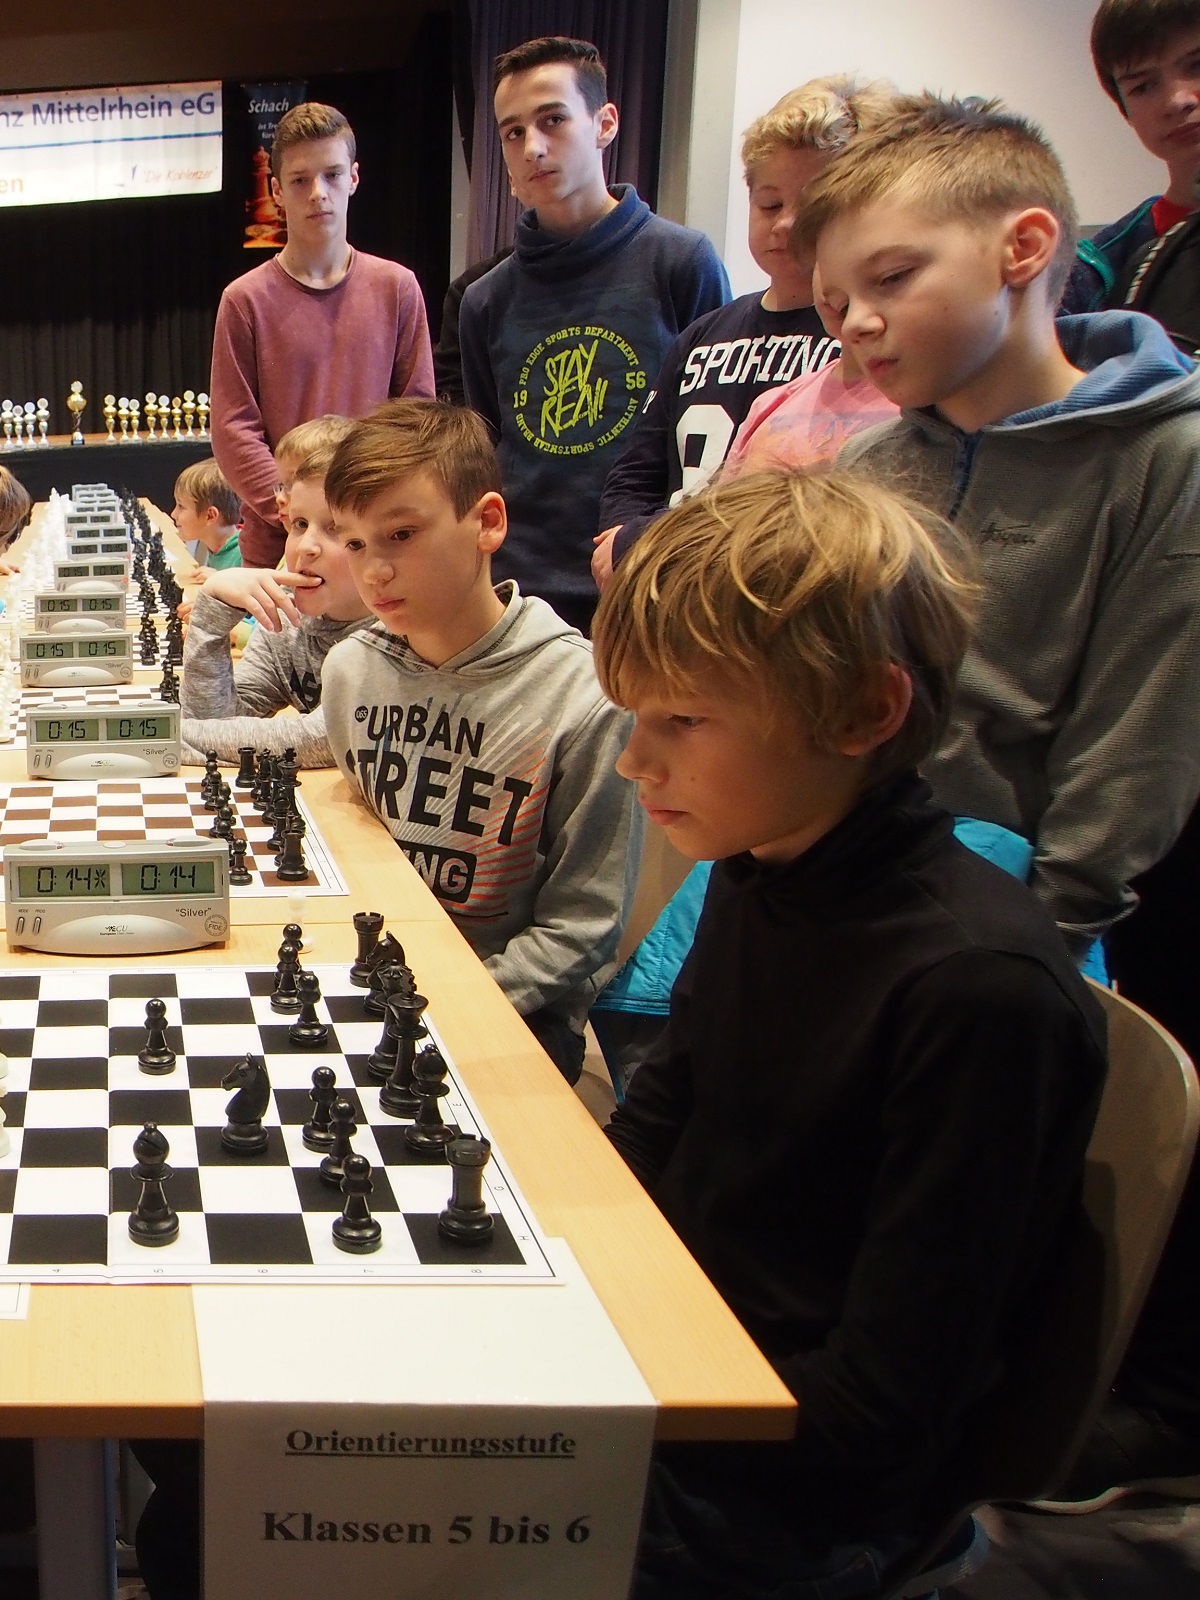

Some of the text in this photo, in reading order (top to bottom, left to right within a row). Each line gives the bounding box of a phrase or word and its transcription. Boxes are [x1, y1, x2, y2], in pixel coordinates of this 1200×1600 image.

[32, 94, 172, 125] Mittelrhein
[181, 92, 215, 116] eG
[248, 97, 290, 114] Schach
[545, 326, 581, 346] SPORTS
[584, 326, 639, 367] DEPARTMENT
[543, 339, 599, 397] STAY
[625, 370, 647, 391] 56
[513, 389, 528, 409] 19
[515, 397, 639, 455] AUTHENTIC SPORTSWEAR BRAND
[367, 704, 485, 758] URBAN
[141, 865, 196, 890] 0:14
[403, 849, 469, 895] NG
[286, 1429, 576, 1456] Orientierungsstufe
[263, 1511, 592, 1544] Klassen 5 bis 6
